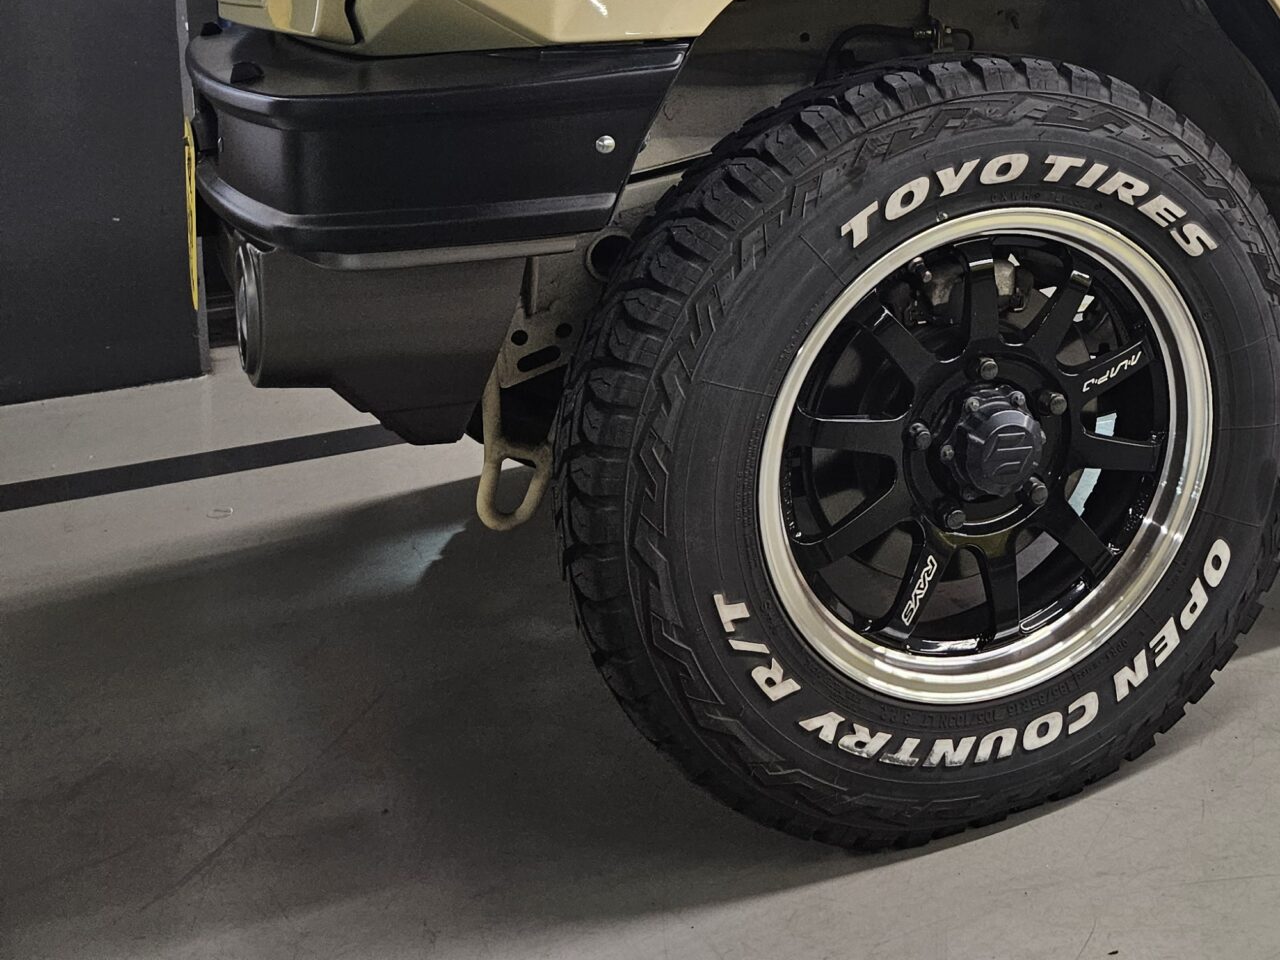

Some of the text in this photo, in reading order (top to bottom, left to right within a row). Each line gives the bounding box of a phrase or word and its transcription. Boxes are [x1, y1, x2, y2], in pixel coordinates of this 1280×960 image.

[840, 153, 1218, 257] TOYO TIRES
[901, 554, 938, 626] RAYS
[1113, 538, 1231, 702] OPEN
[713, 593, 802, 702] R/T
[798, 690, 1100, 768] COUNTRY
